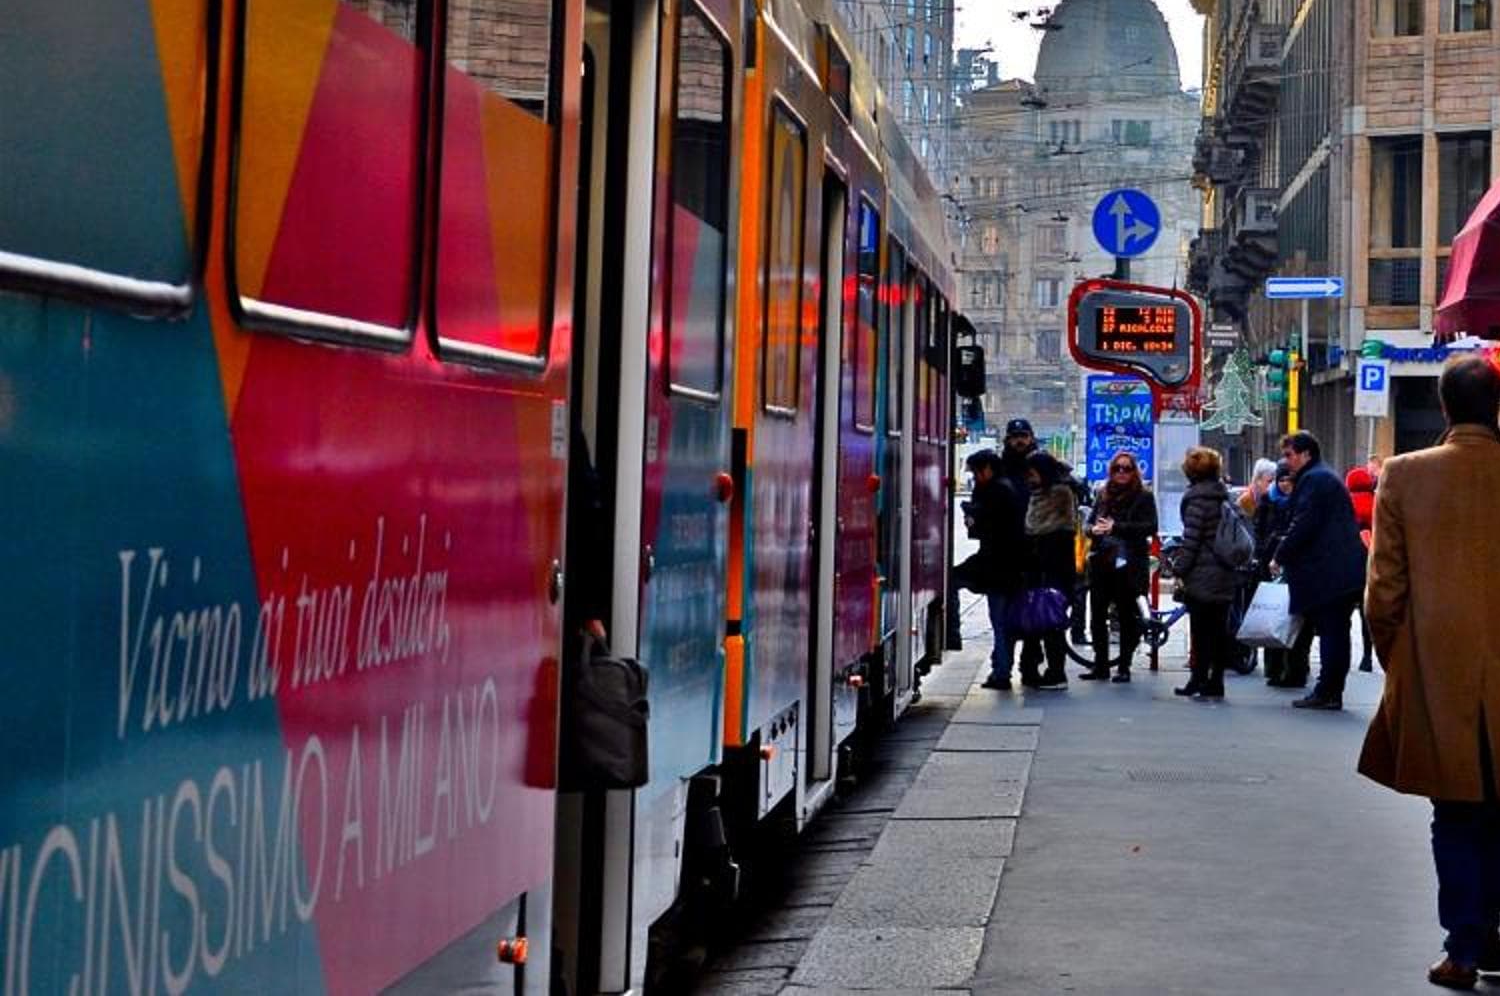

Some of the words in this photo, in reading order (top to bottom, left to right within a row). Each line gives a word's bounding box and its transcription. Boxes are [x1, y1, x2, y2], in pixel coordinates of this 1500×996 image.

[1091, 402, 1151, 424] TRAM
[1365, 367, 1381, 389] P
[117, 547, 242, 739] Vicino
[248, 547, 289, 701] ai
[291, 538, 356, 689] tuoi
[0, 731, 328, 996] ICINISSIMO
[335, 722, 365, 902] A
[374, 674, 500, 880] MILANO
